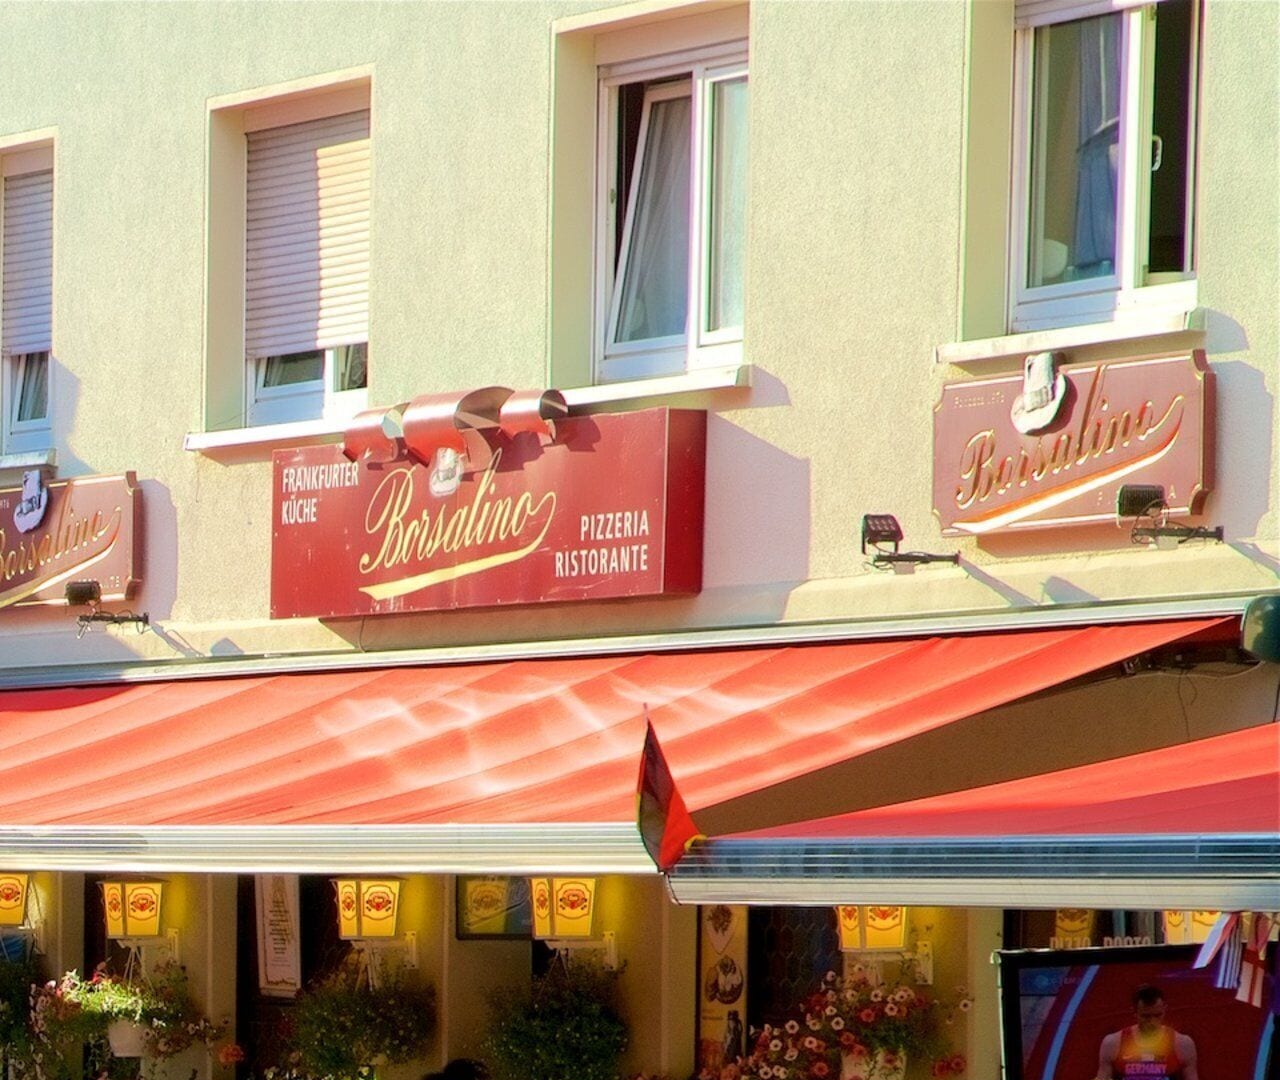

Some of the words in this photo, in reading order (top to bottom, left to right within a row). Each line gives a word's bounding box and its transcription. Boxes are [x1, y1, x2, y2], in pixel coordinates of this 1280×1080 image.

[954, 370, 1184, 509] Borsalino
[282, 462, 359, 494] FRANKFURTER
[282, 493, 318, 524] KÜCHE
[359, 446, 557, 574] Borsalino
[580, 510, 649, 541] PIZZERIA
[555, 544, 648, 578] RISTORANTE
[1125, 1063, 1168, 1074] GERMANY
